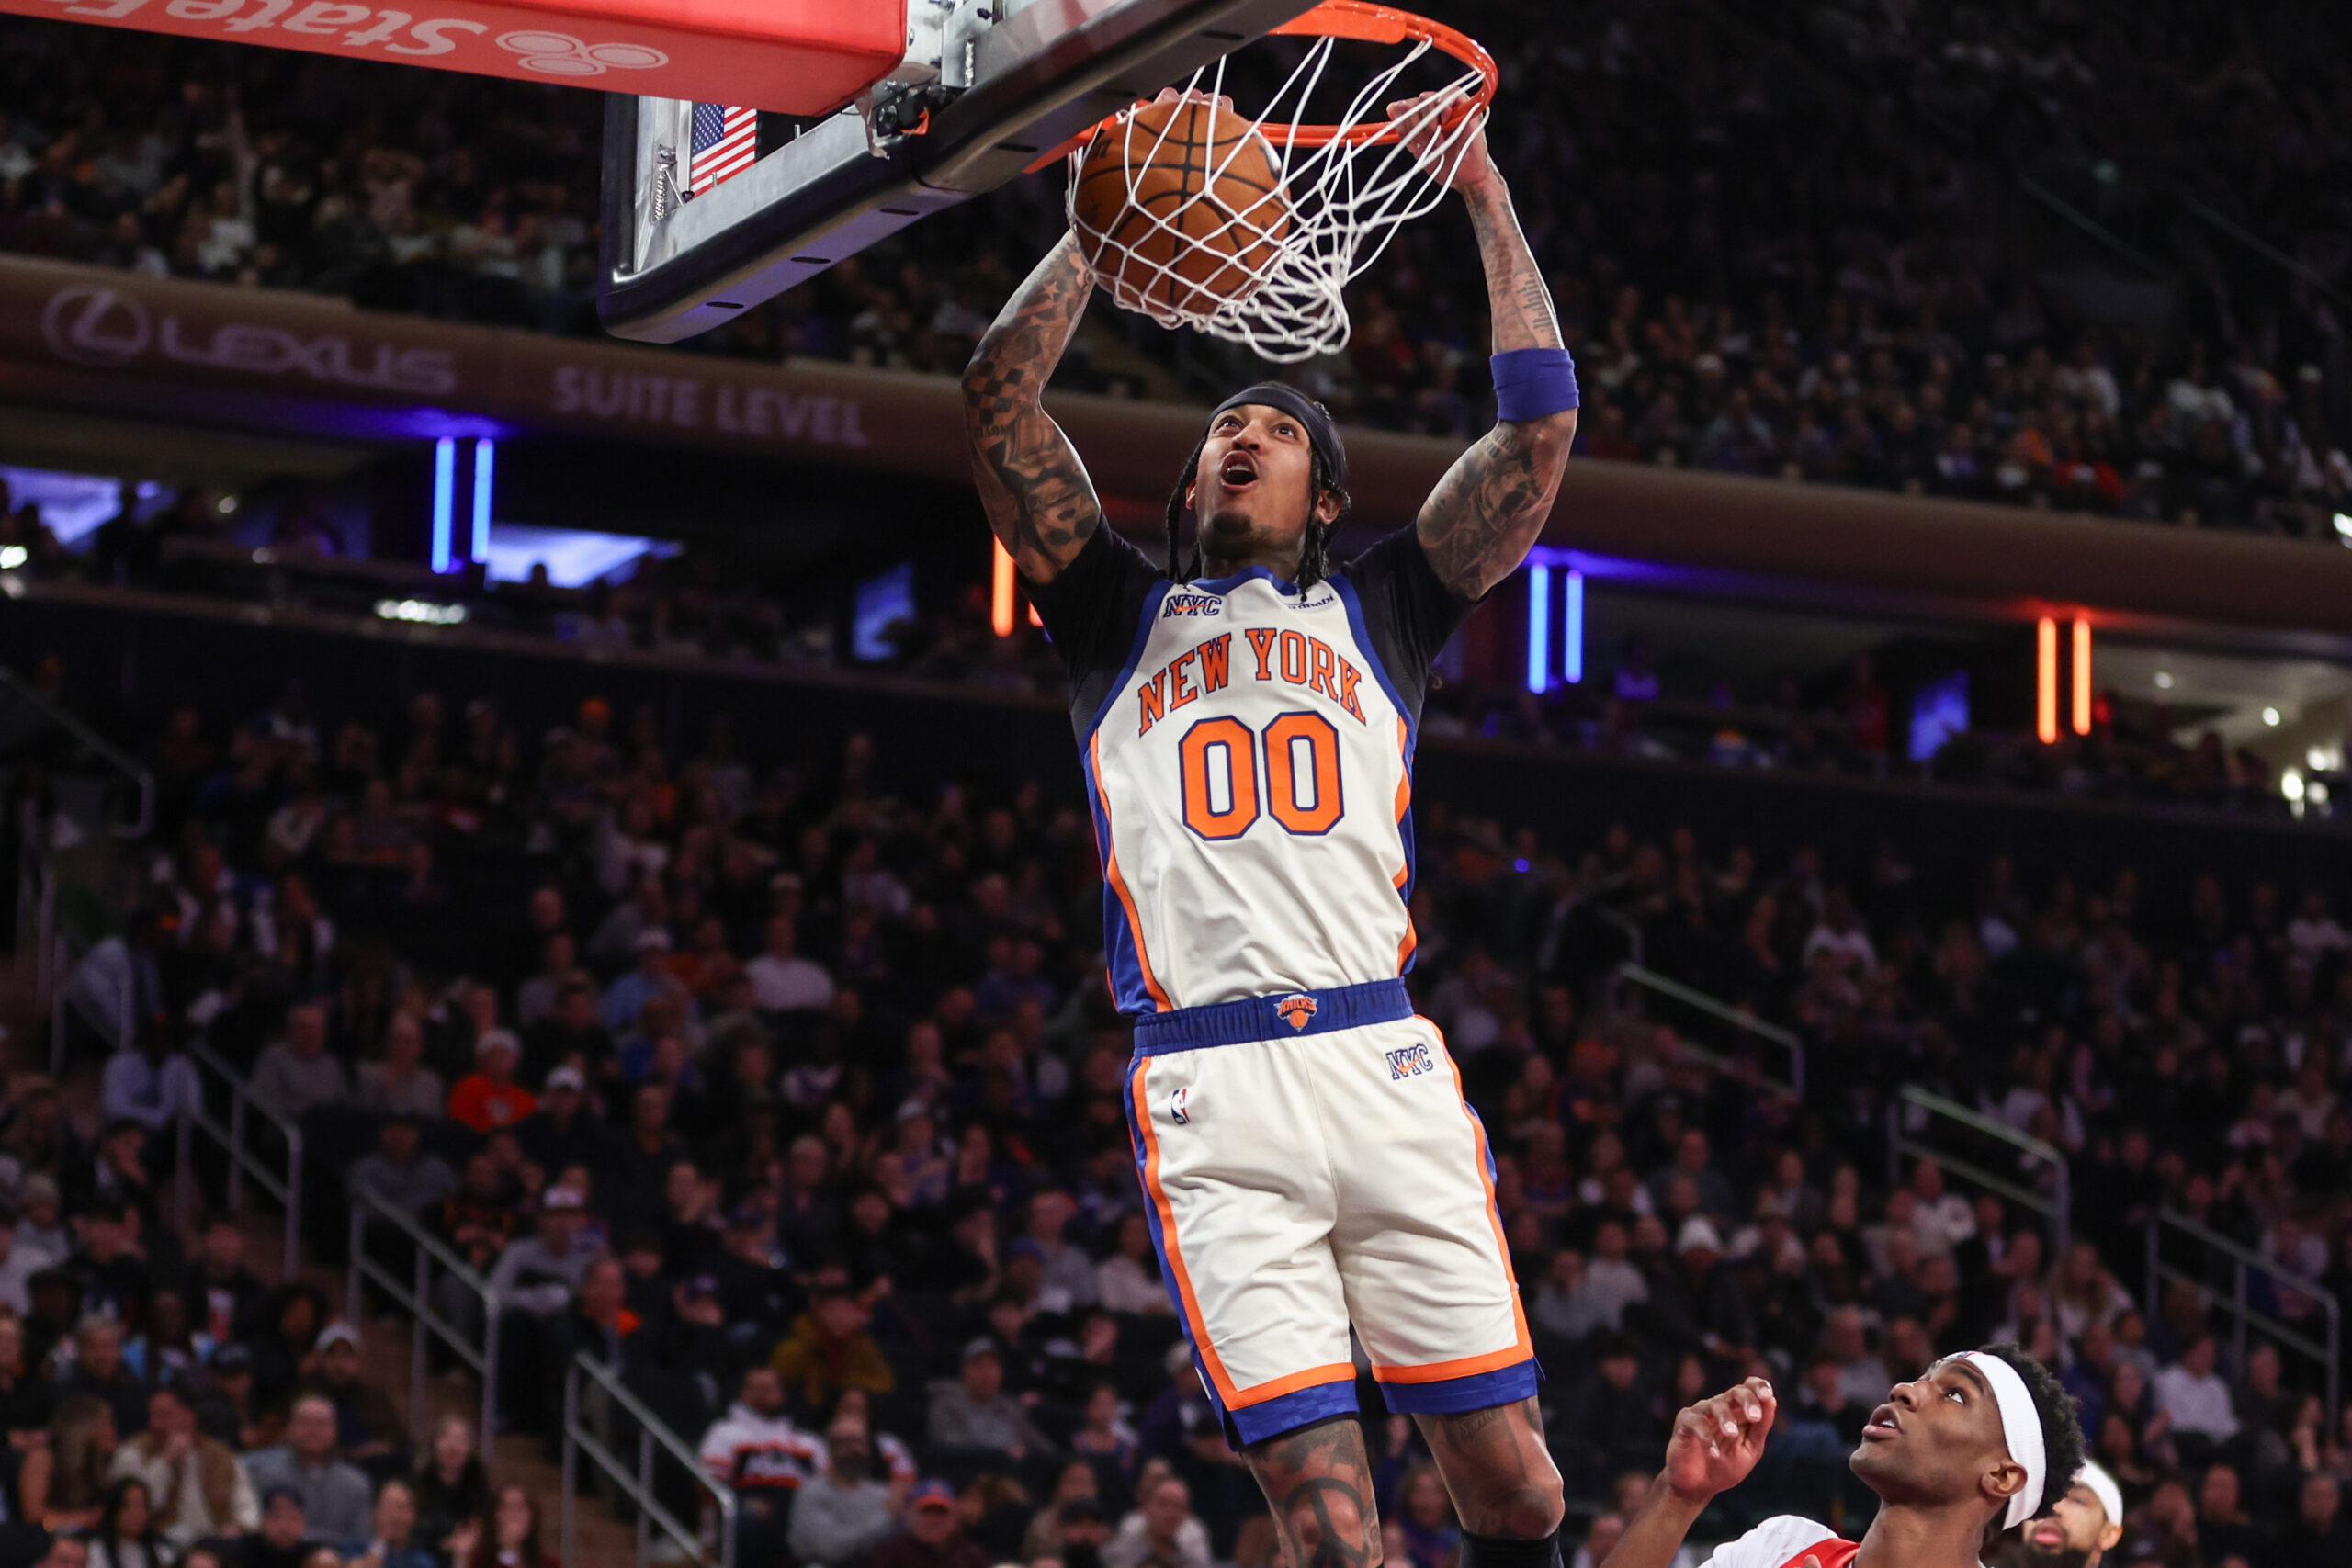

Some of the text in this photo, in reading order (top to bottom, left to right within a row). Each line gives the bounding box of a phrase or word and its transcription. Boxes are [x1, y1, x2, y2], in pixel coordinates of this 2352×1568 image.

[157, 314, 458, 396] LEXUS
[553, 364, 868, 447] SUITE LEVEL
[1162, 593, 1223, 618] NYC
[1137, 627, 1367, 739] NEW YORK
[1178, 710, 1345, 841] 00
[1277, 996, 1317, 1017] KNICKS
[1385, 1043, 1434, 1080] NYC
